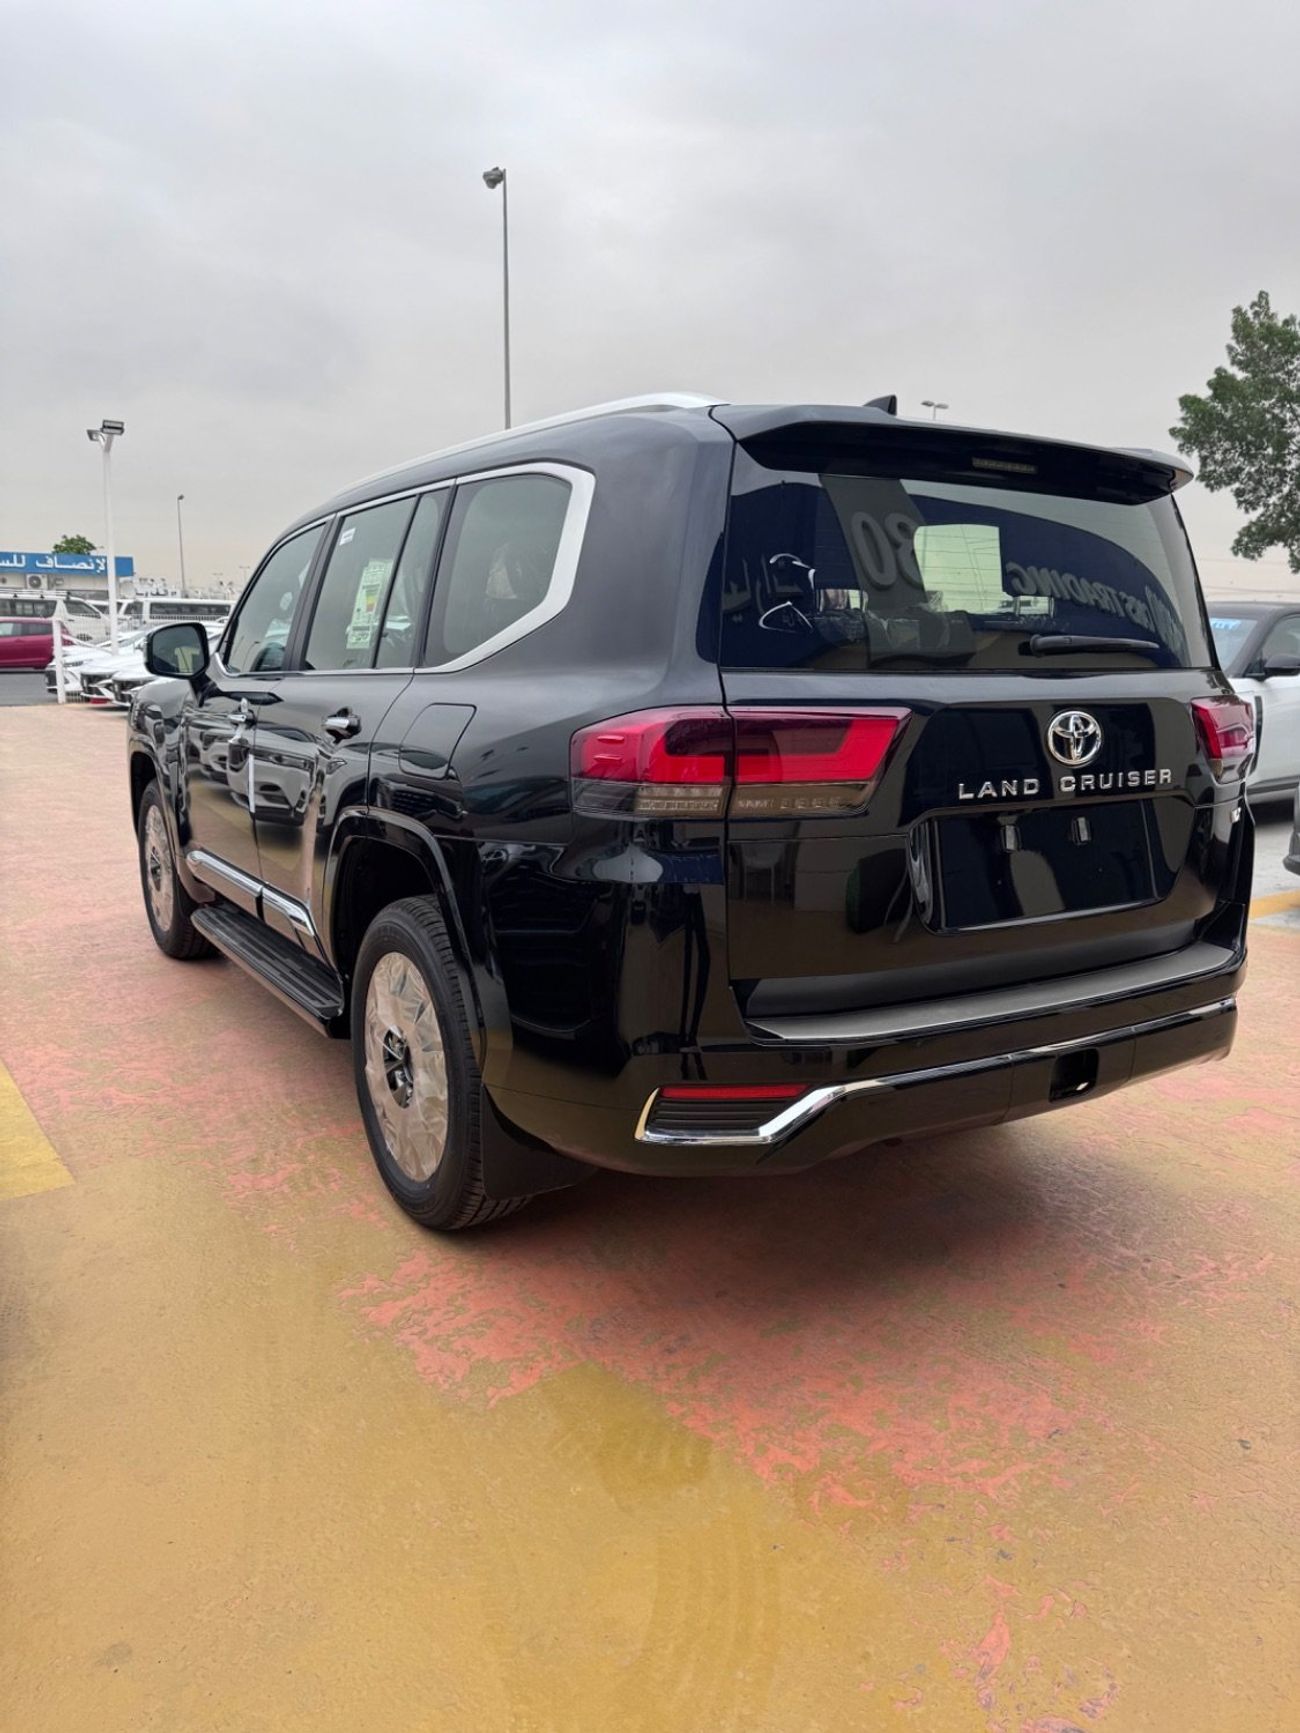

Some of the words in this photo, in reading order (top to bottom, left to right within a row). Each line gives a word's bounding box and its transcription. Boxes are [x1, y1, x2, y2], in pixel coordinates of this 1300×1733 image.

[35, 554, 106, 573] لإنصاف
[958, 778, 1041, 800] LAND
[1058, 767, 1173, 794] CRUISER
